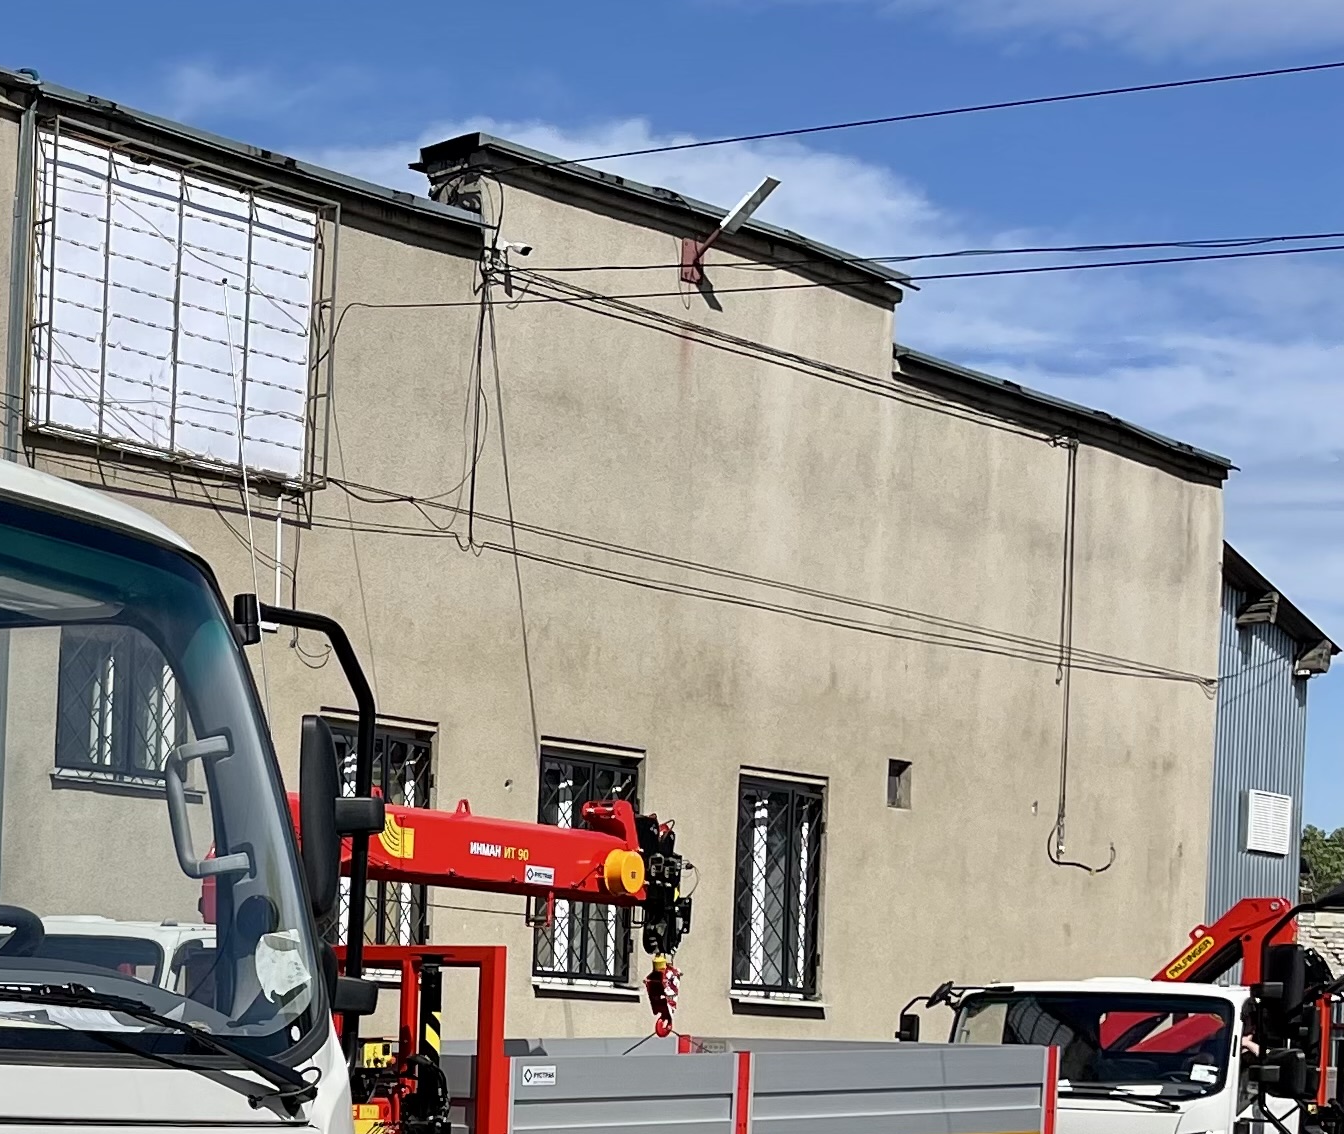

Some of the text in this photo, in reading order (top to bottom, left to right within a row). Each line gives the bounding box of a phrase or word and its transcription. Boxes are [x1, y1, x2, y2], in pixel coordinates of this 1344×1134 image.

[470, 841, 502, 858] ИНМАН
[518, 848, 529, 861] 90
[1168, 939, 1212, 978] PALFINGER
